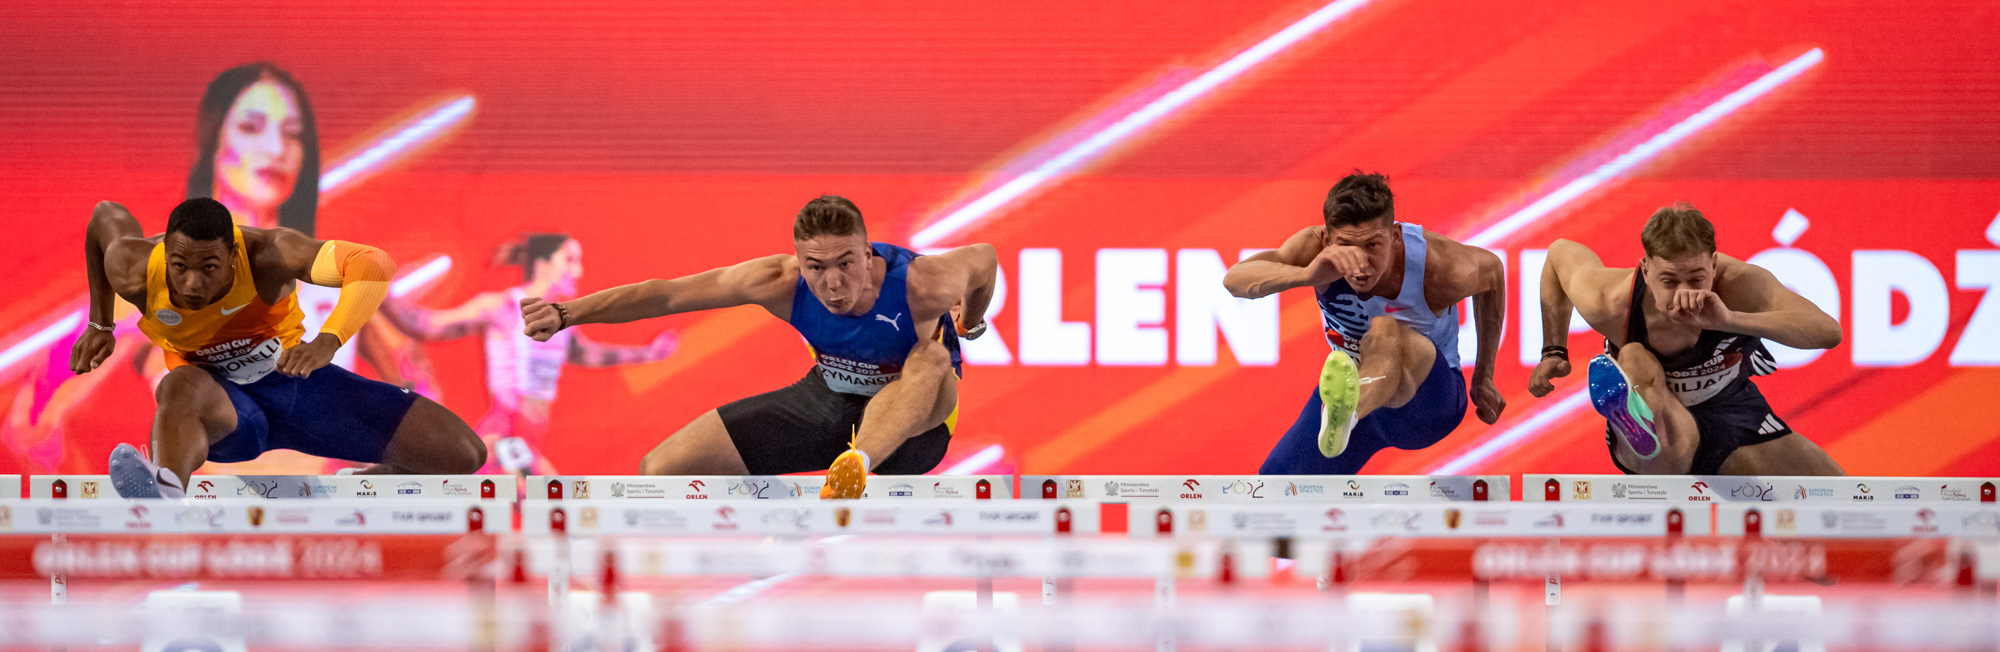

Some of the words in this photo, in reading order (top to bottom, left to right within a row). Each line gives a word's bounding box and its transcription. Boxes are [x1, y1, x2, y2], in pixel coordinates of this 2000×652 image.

[196, 342, 232, 356] ORLEN
[821, 354, 857, 367] ORLEN
[1703, 354, 1725, 367] CUP
[1701, 364, 1726, 375] 2024
